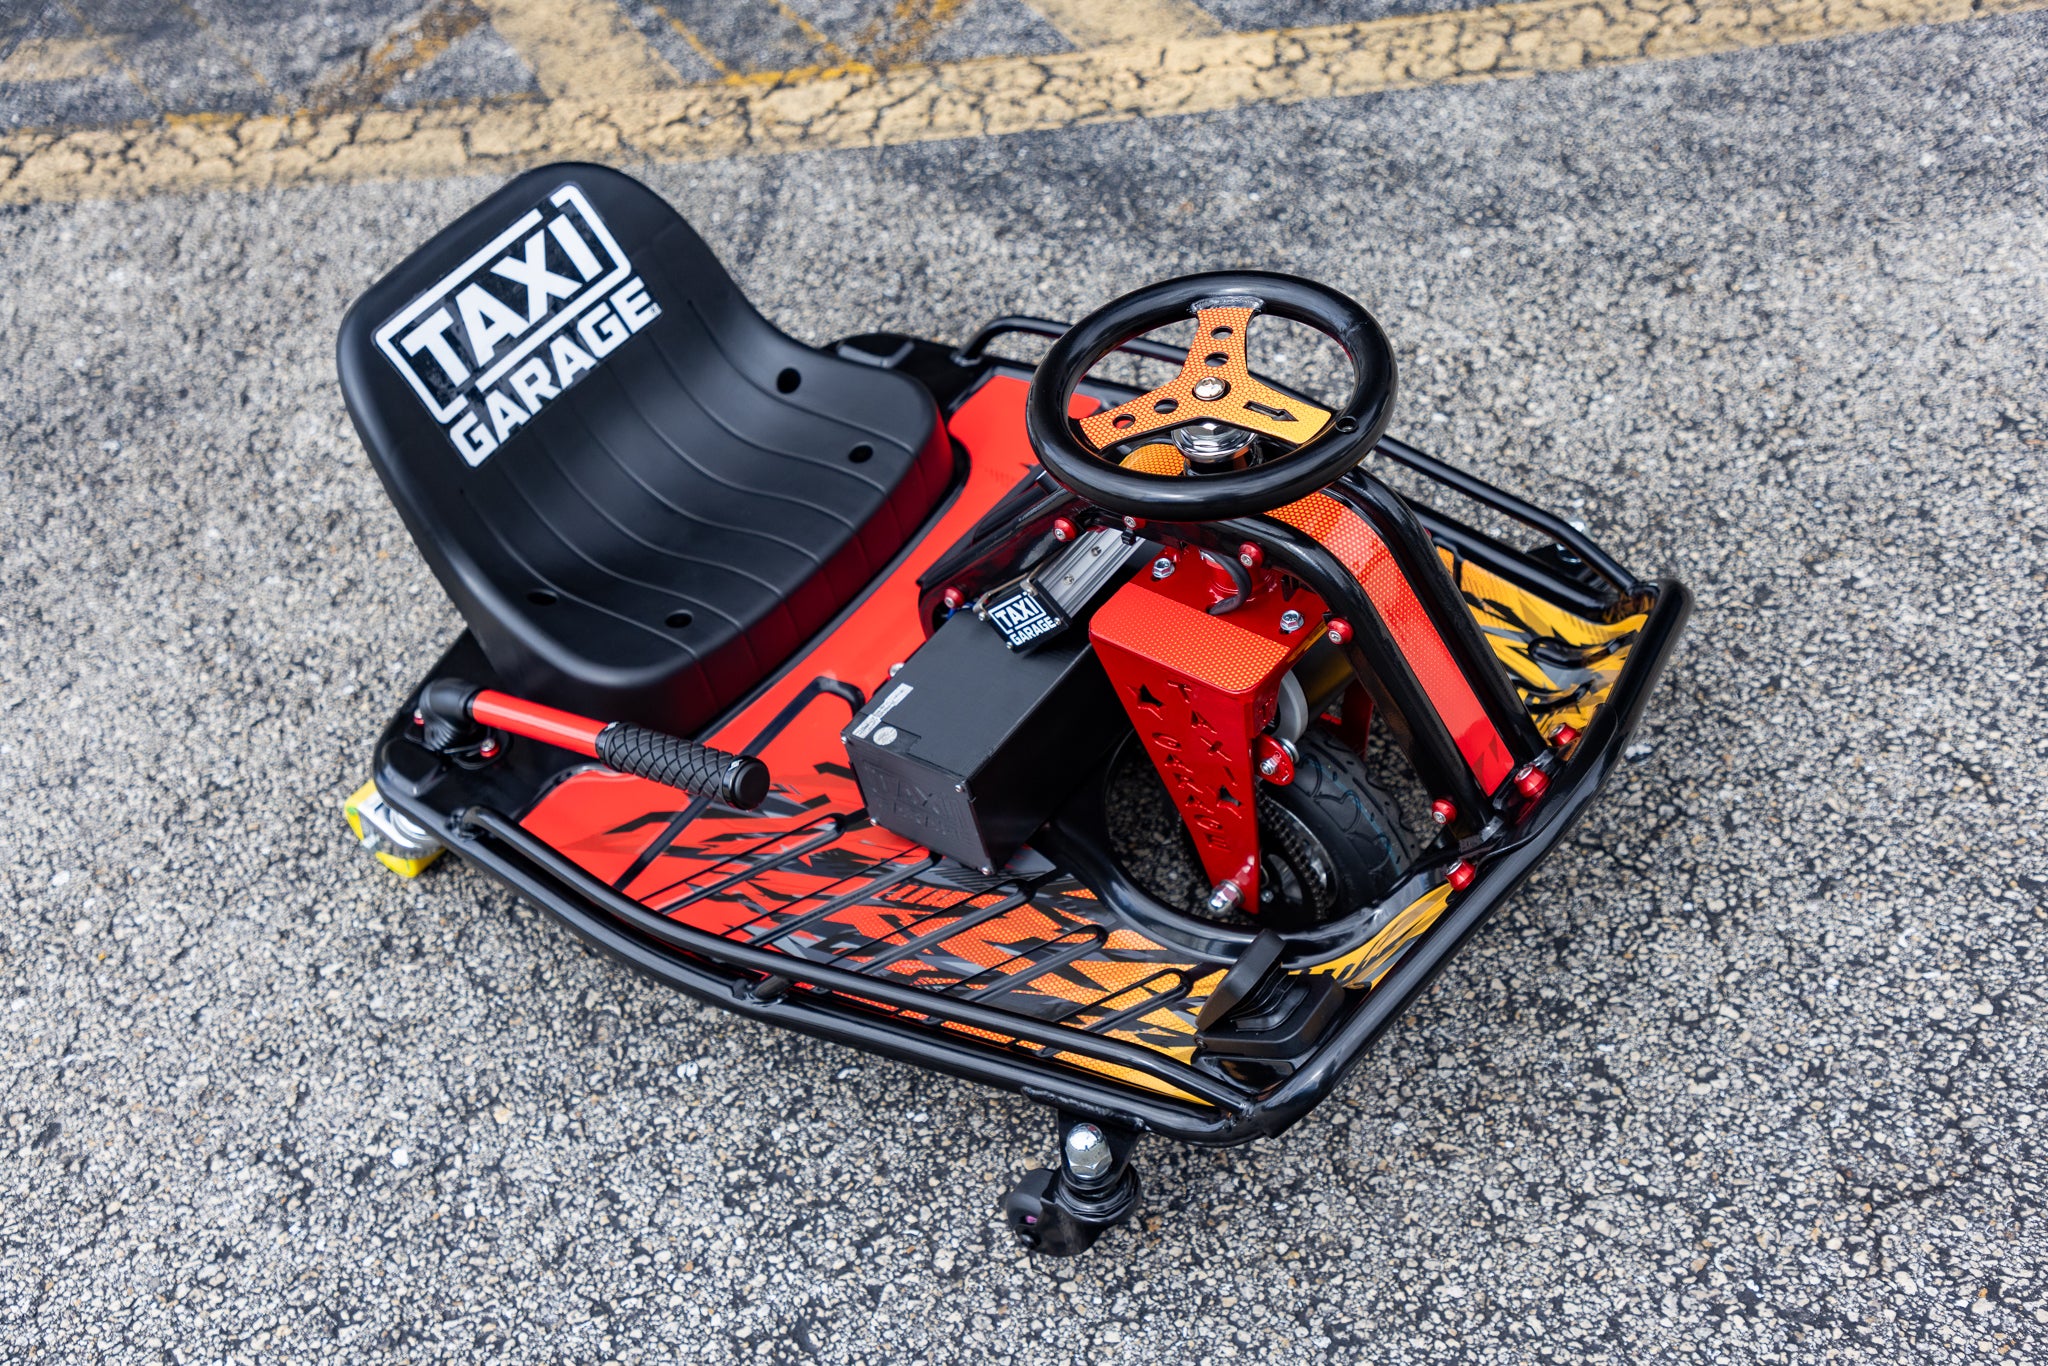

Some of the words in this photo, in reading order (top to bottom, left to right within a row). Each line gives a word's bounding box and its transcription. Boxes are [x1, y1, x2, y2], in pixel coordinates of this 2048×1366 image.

[400, 213, 604, 388] TAXI
[450, 275, 662, 468] GARAGE
[994, 597, 1040, 628] TAXI
[1009, 615, 1057, 646] GARAGE
[1167, 680, 1238, 787] TAXI
[1151, 731, 1229, 853] GARAGE
